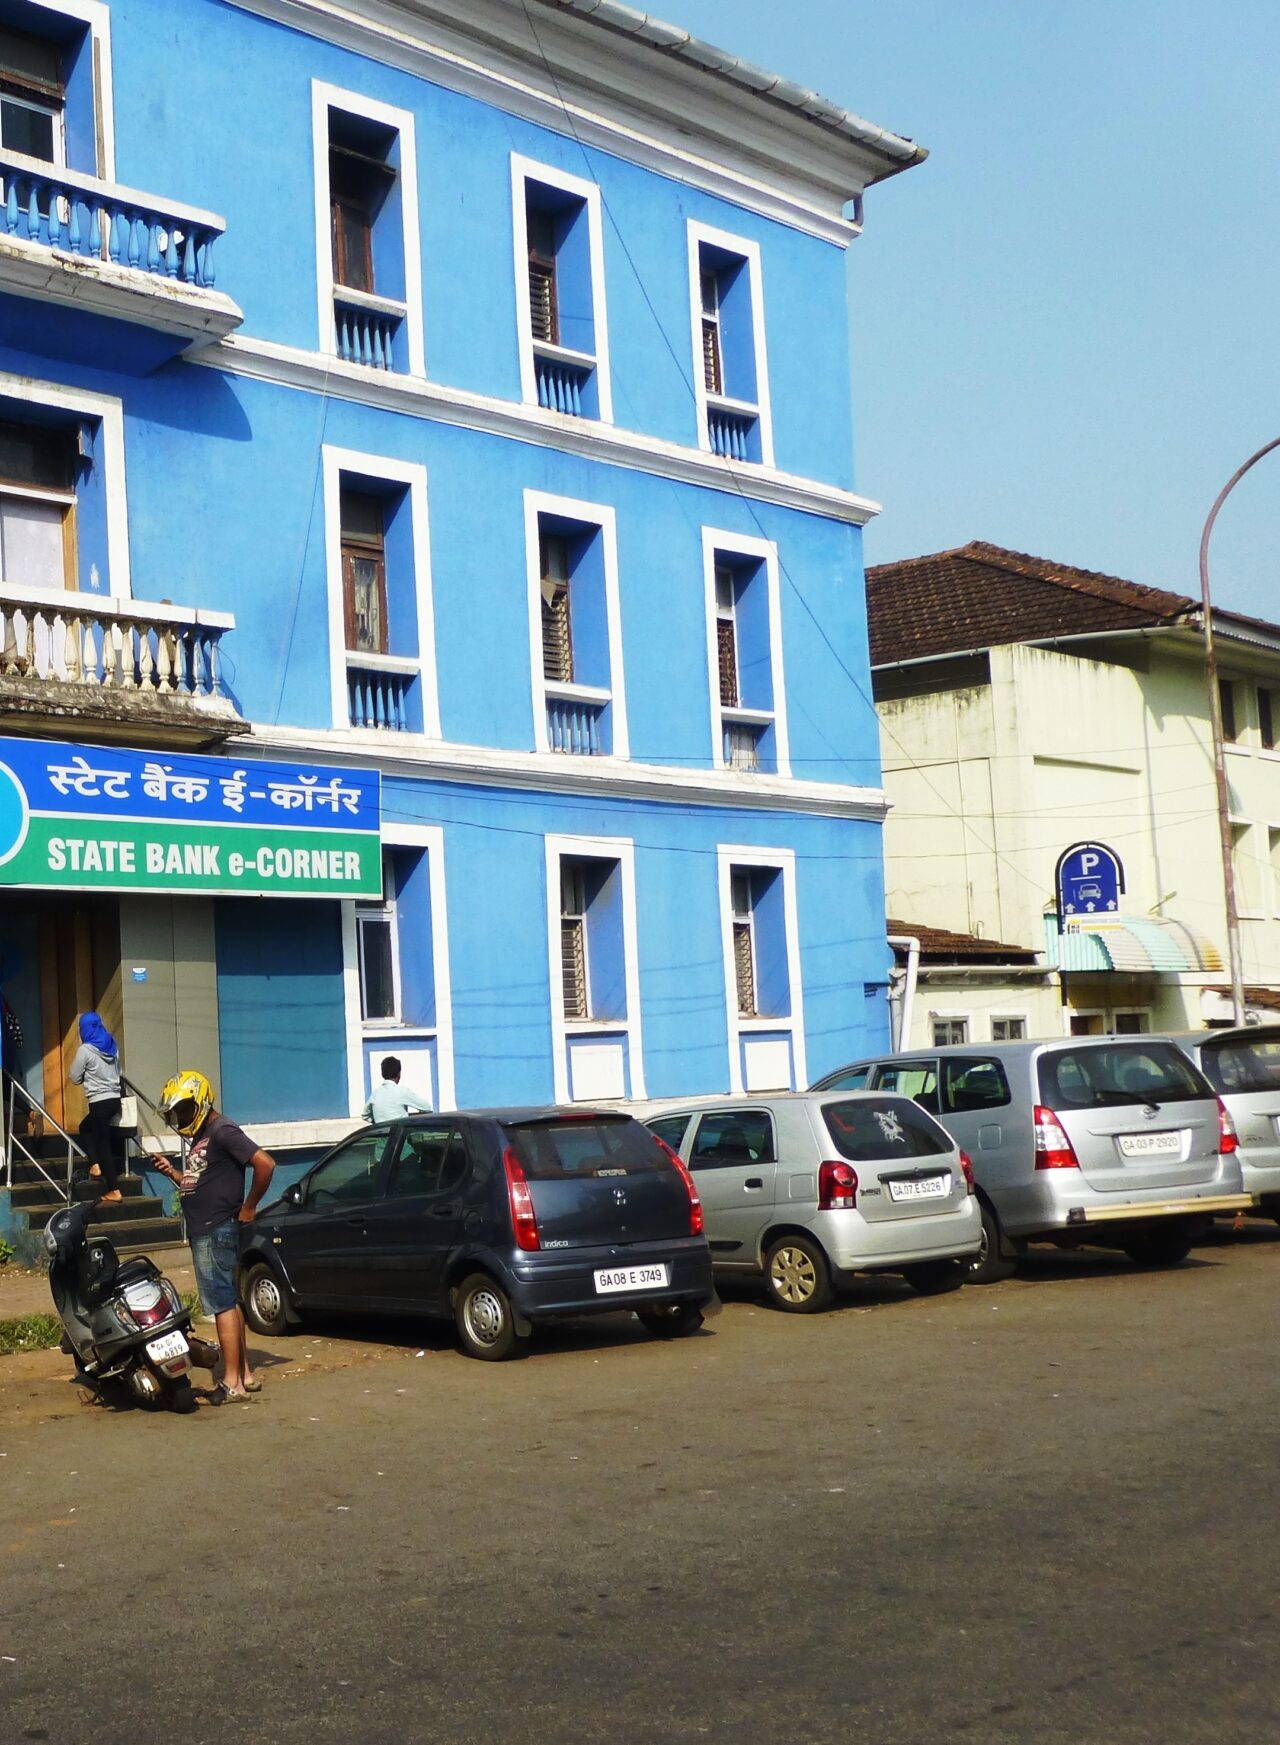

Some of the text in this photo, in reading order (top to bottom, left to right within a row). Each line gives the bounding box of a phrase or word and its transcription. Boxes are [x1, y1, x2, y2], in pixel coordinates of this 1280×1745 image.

[47, 756, 131, 799] स्टेट
[141, 763, 209, 803] बैंक
[48, 837, 361, 880] STATE BANK e-CORNER
[1081, 853, 1099, 876] P
[629, 1272, 637, 1284] E
[640, 1269, 662, 1283] 3749
